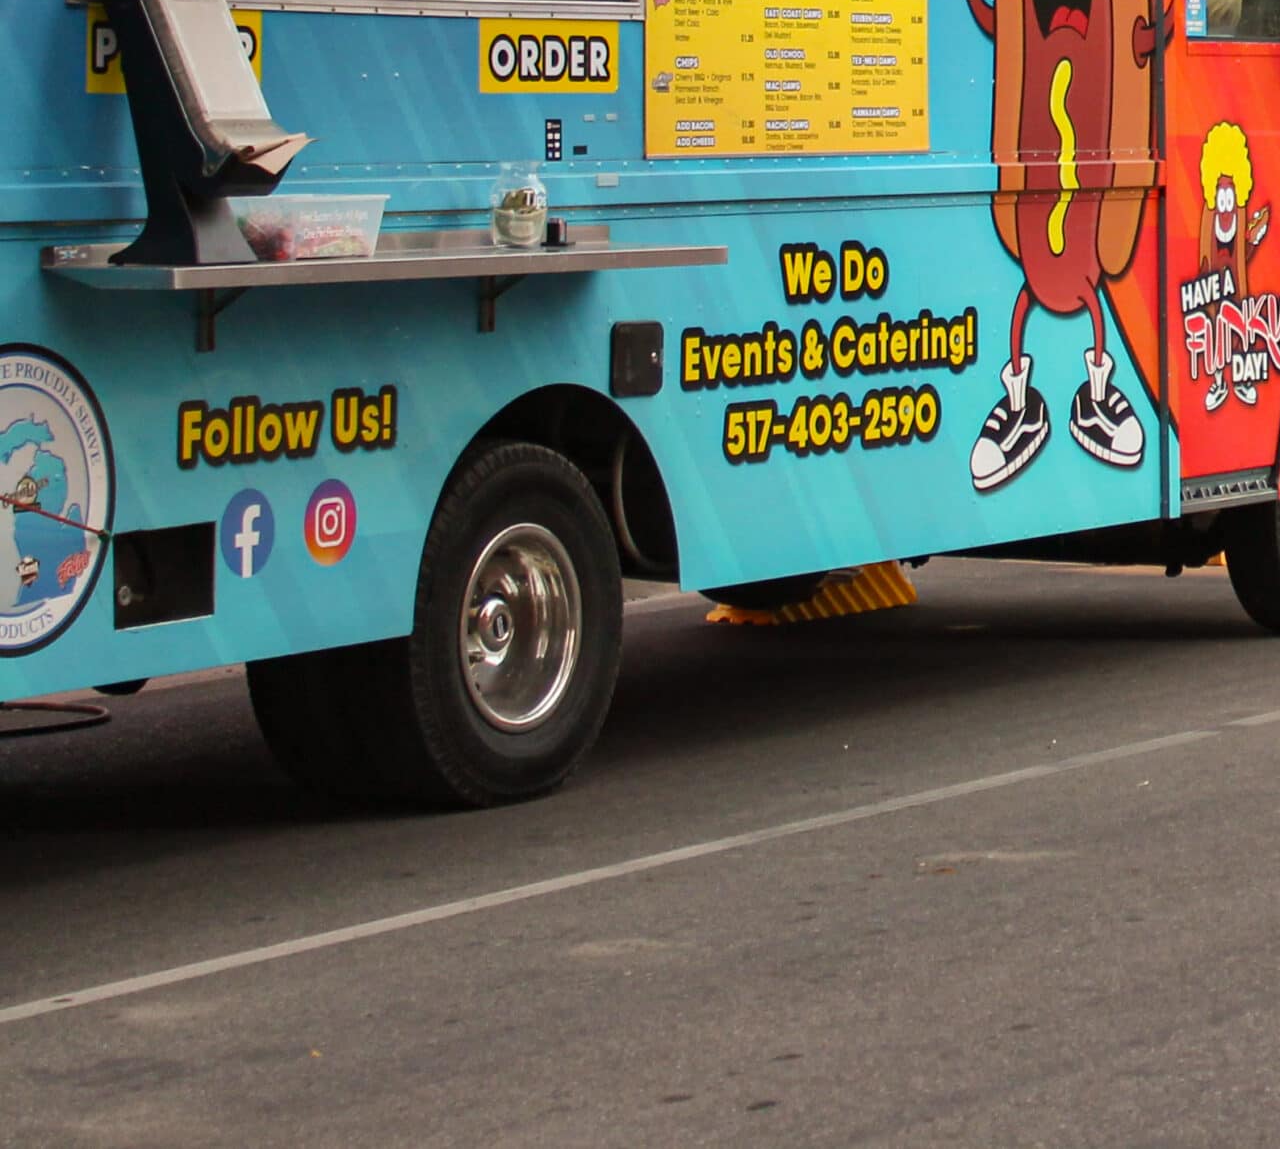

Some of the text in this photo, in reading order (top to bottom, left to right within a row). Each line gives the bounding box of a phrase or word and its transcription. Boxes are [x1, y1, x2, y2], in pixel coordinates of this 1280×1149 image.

[490, 36, 610, 80] ORDER
[676, 56, 699, 70] CHIPS
[676, 120, 691, 132] ADD
[676, 136, 691, 147] ADD
[783, 248, 885, 296] We Do
[1181, 269, 1236, 312] HAVE A
[683, 314, 975, 383] Events & Catering!
[1231, 352, 1268, 383] DAY!
[15, 362, 79, 407] PROUDLY
[75, 405, 101, 467] SERVE
[180, 390, 395, 465] Follow Us!
[726, 391, 938, 458] 517-403-2590
